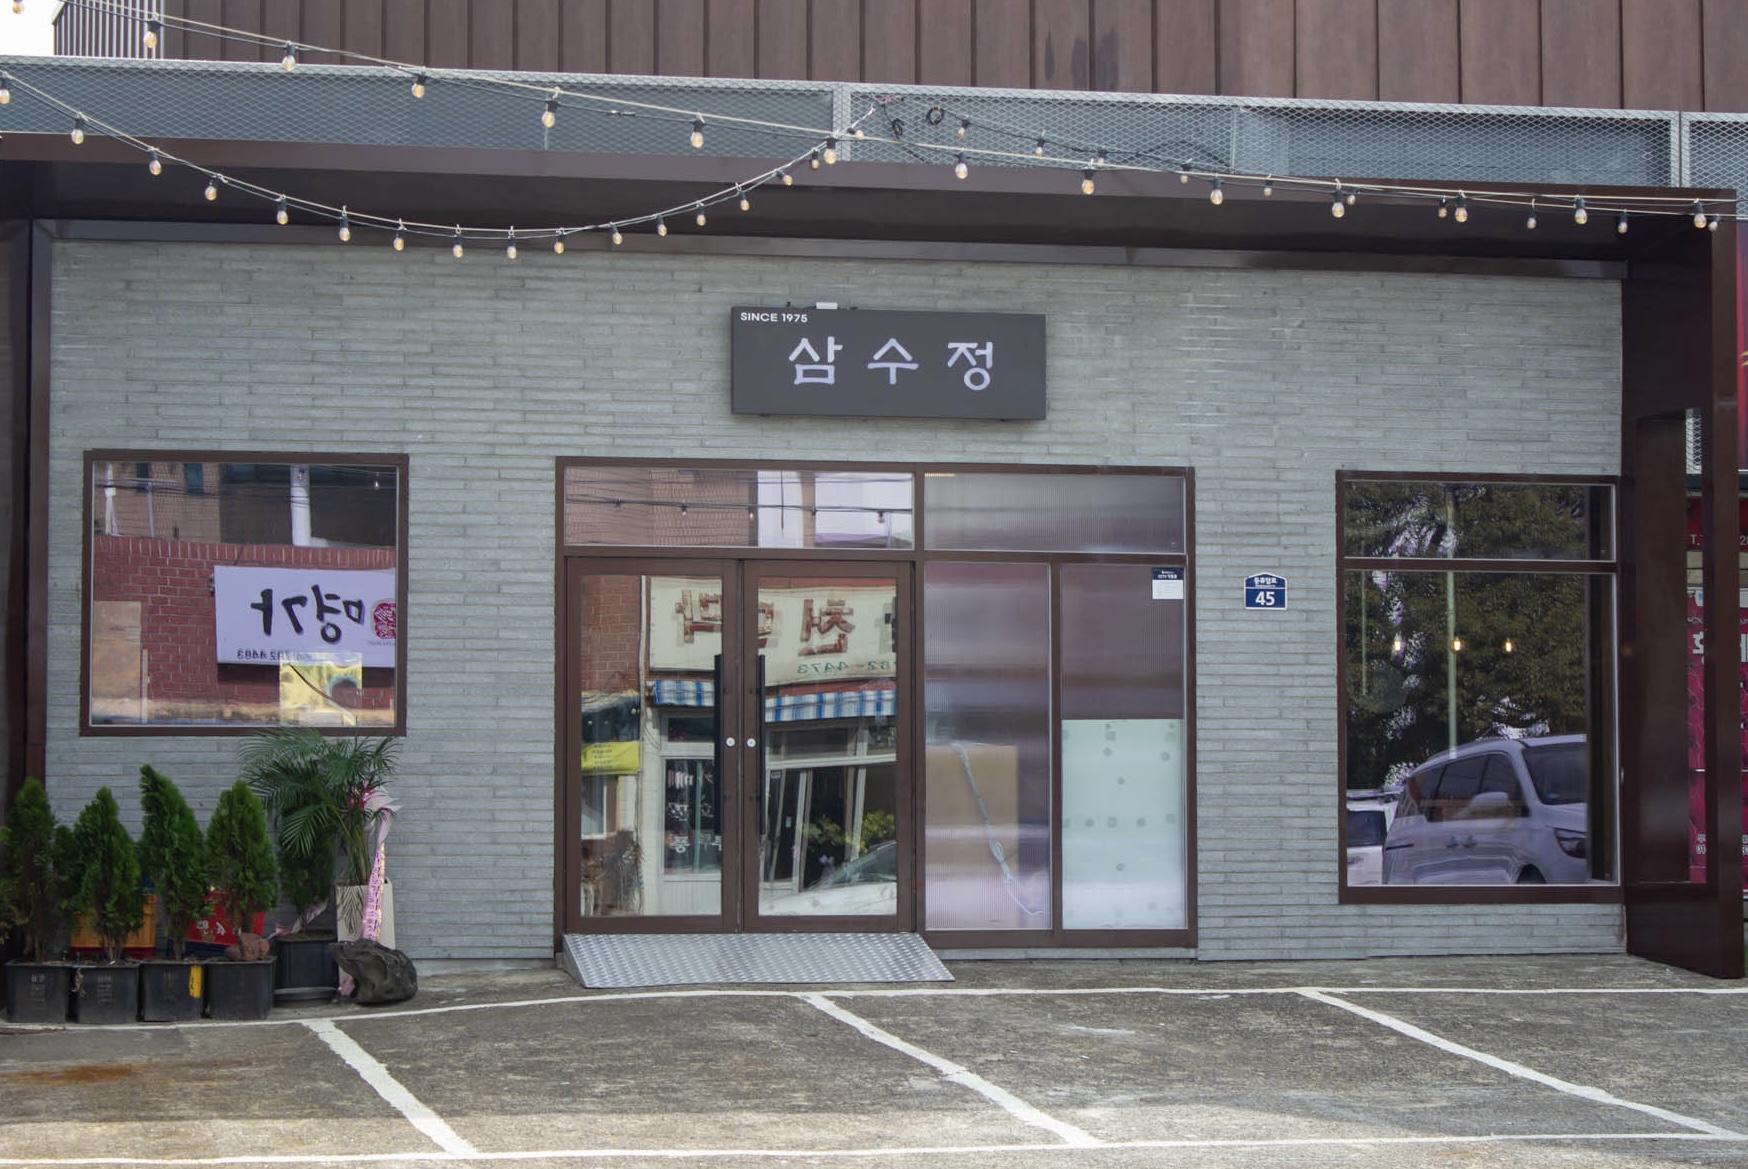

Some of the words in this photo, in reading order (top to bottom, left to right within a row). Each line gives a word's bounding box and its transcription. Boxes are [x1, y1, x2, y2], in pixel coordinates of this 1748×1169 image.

[740, 312, 778, 322] SINCE
[781, 313, 808, 323] 1975
[789, 336, 994, 391] 삼수정
[1255, 591, 1276, 606] 45
